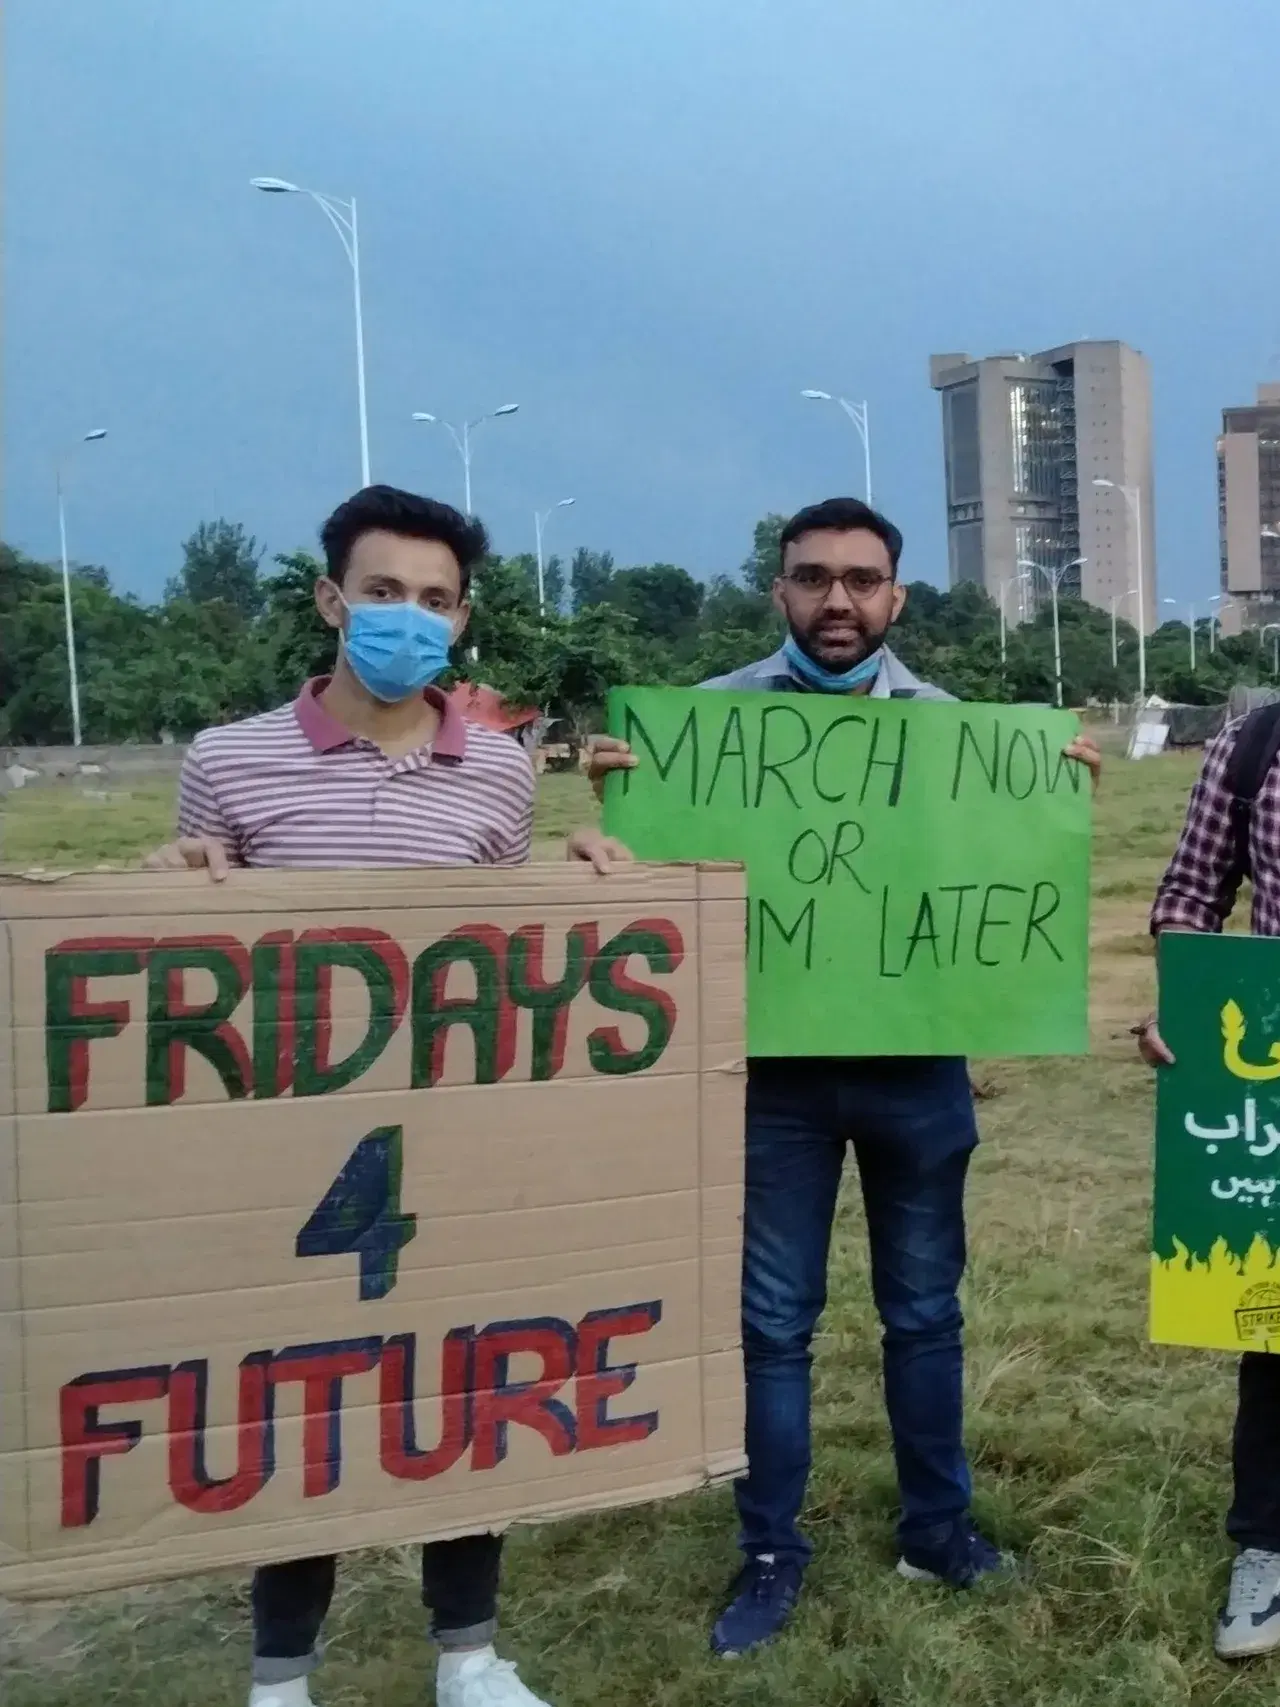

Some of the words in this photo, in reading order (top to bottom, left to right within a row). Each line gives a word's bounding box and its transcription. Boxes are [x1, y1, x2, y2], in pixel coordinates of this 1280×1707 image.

[623, 702, 907, 809] MARCH
[951, 717, 1081, 801] NOW
[788, 820, 872, 894] OR
[879, 881, 1063, 978] LATER
[45, 917, 685, 1114] FRIDAYS
[295, 1124, 417, 1302] 4
[60, 1299, 663, 1529] FUTURE
